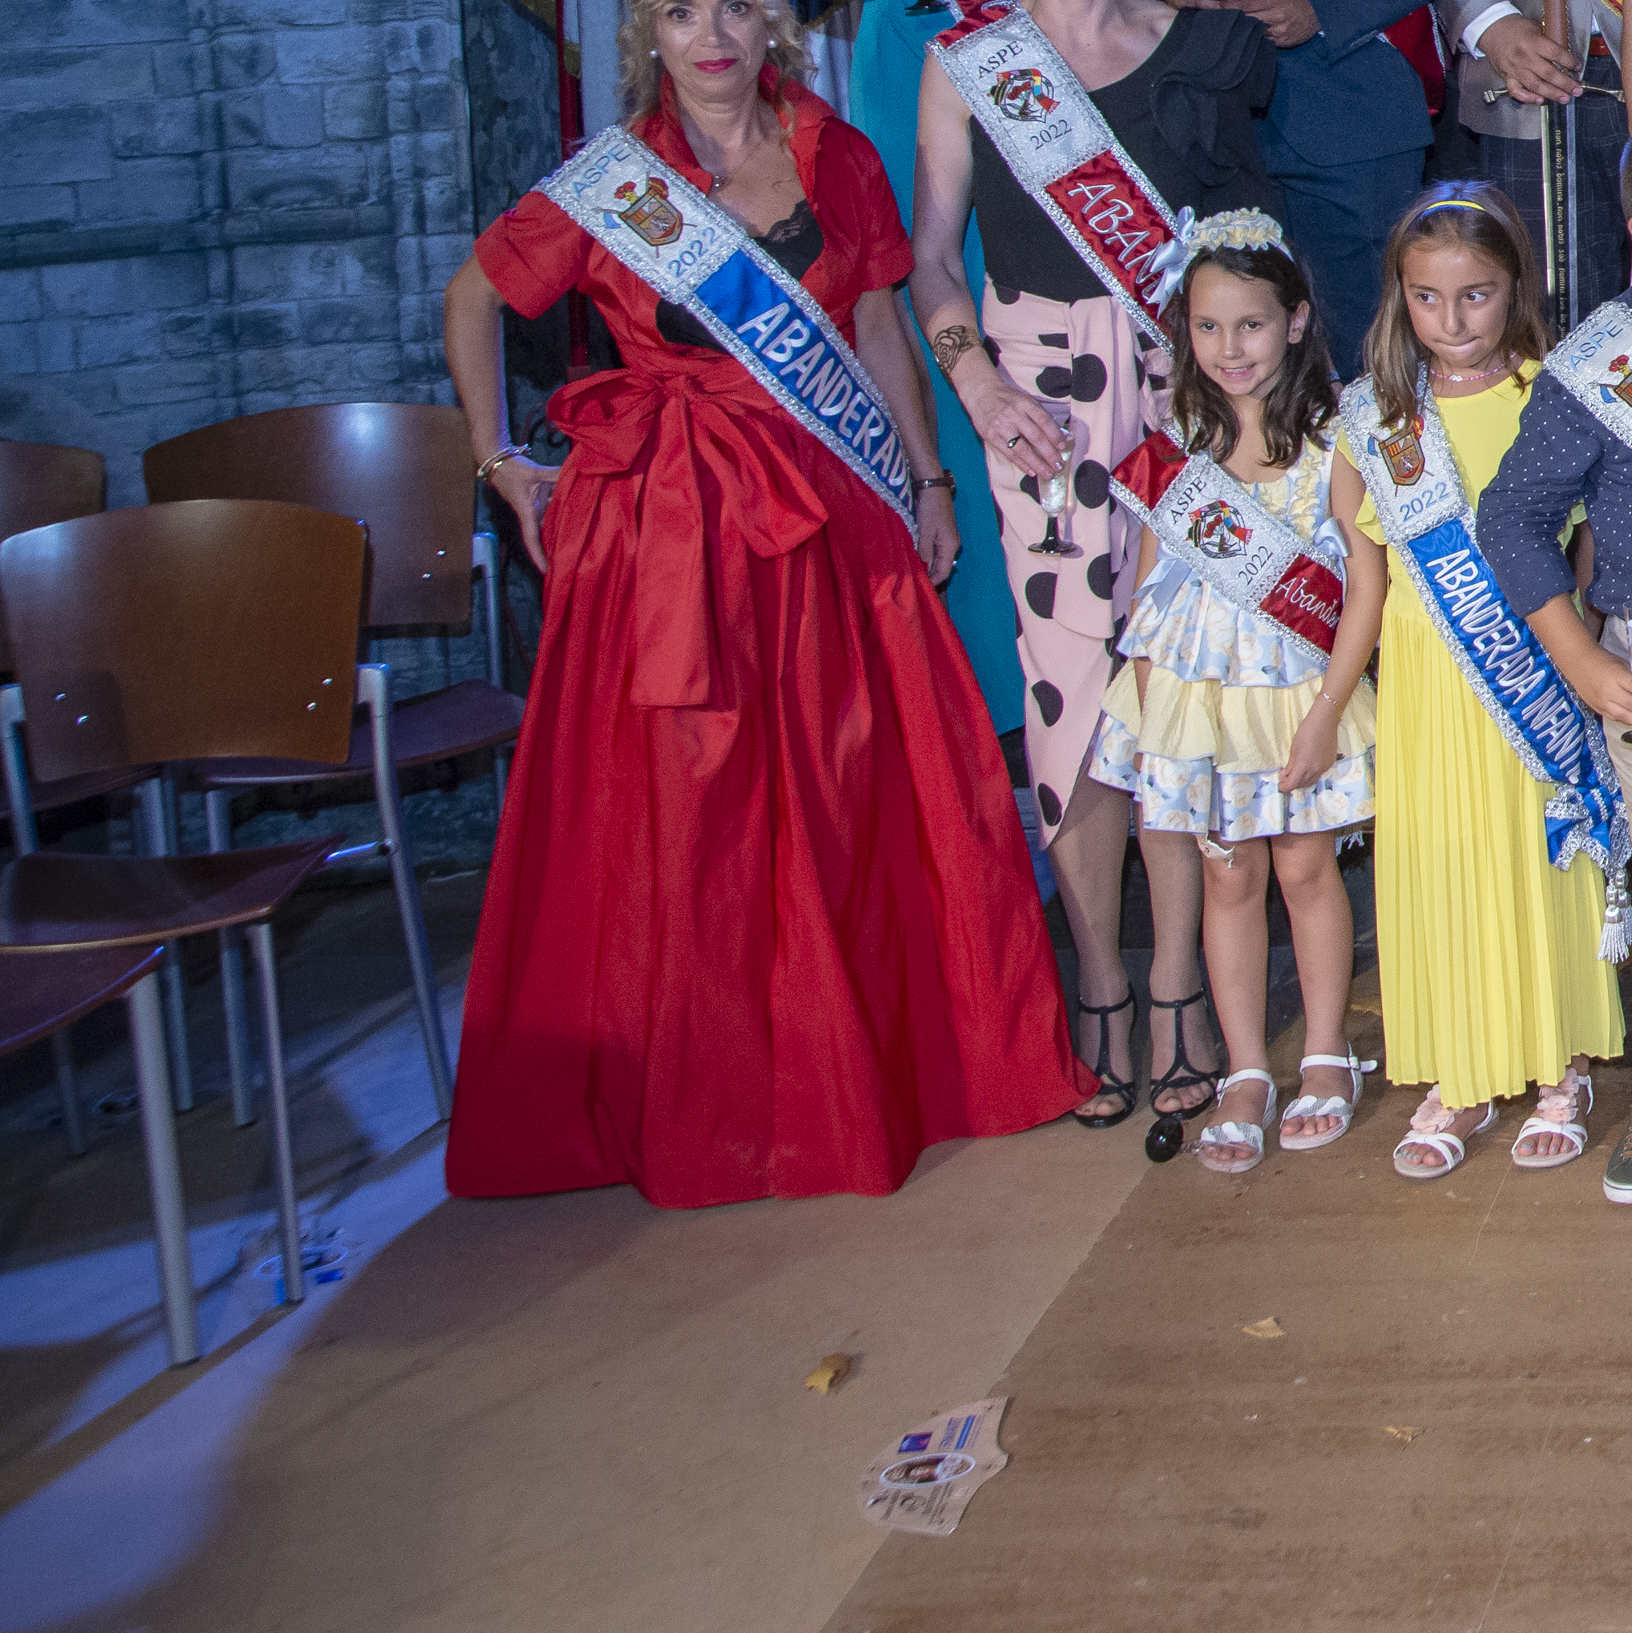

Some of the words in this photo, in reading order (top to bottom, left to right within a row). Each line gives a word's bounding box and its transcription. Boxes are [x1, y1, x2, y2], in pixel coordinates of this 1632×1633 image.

[976, 40, 1024, 79] ASPE
[1030, 119, 1072, 150] 2022
[569, 142, 632, 200] ASPE
[667, 225, 719, 279] 2022
[1568, 318, 1624, 372] ASPE
[1170, 476, 1207, 524] ASPE
[1400, 481, 1449, 521] 2022
[1238, 545, 1274, 585] 2022
[1426, 549, 1546, 706] ABANDERADA
